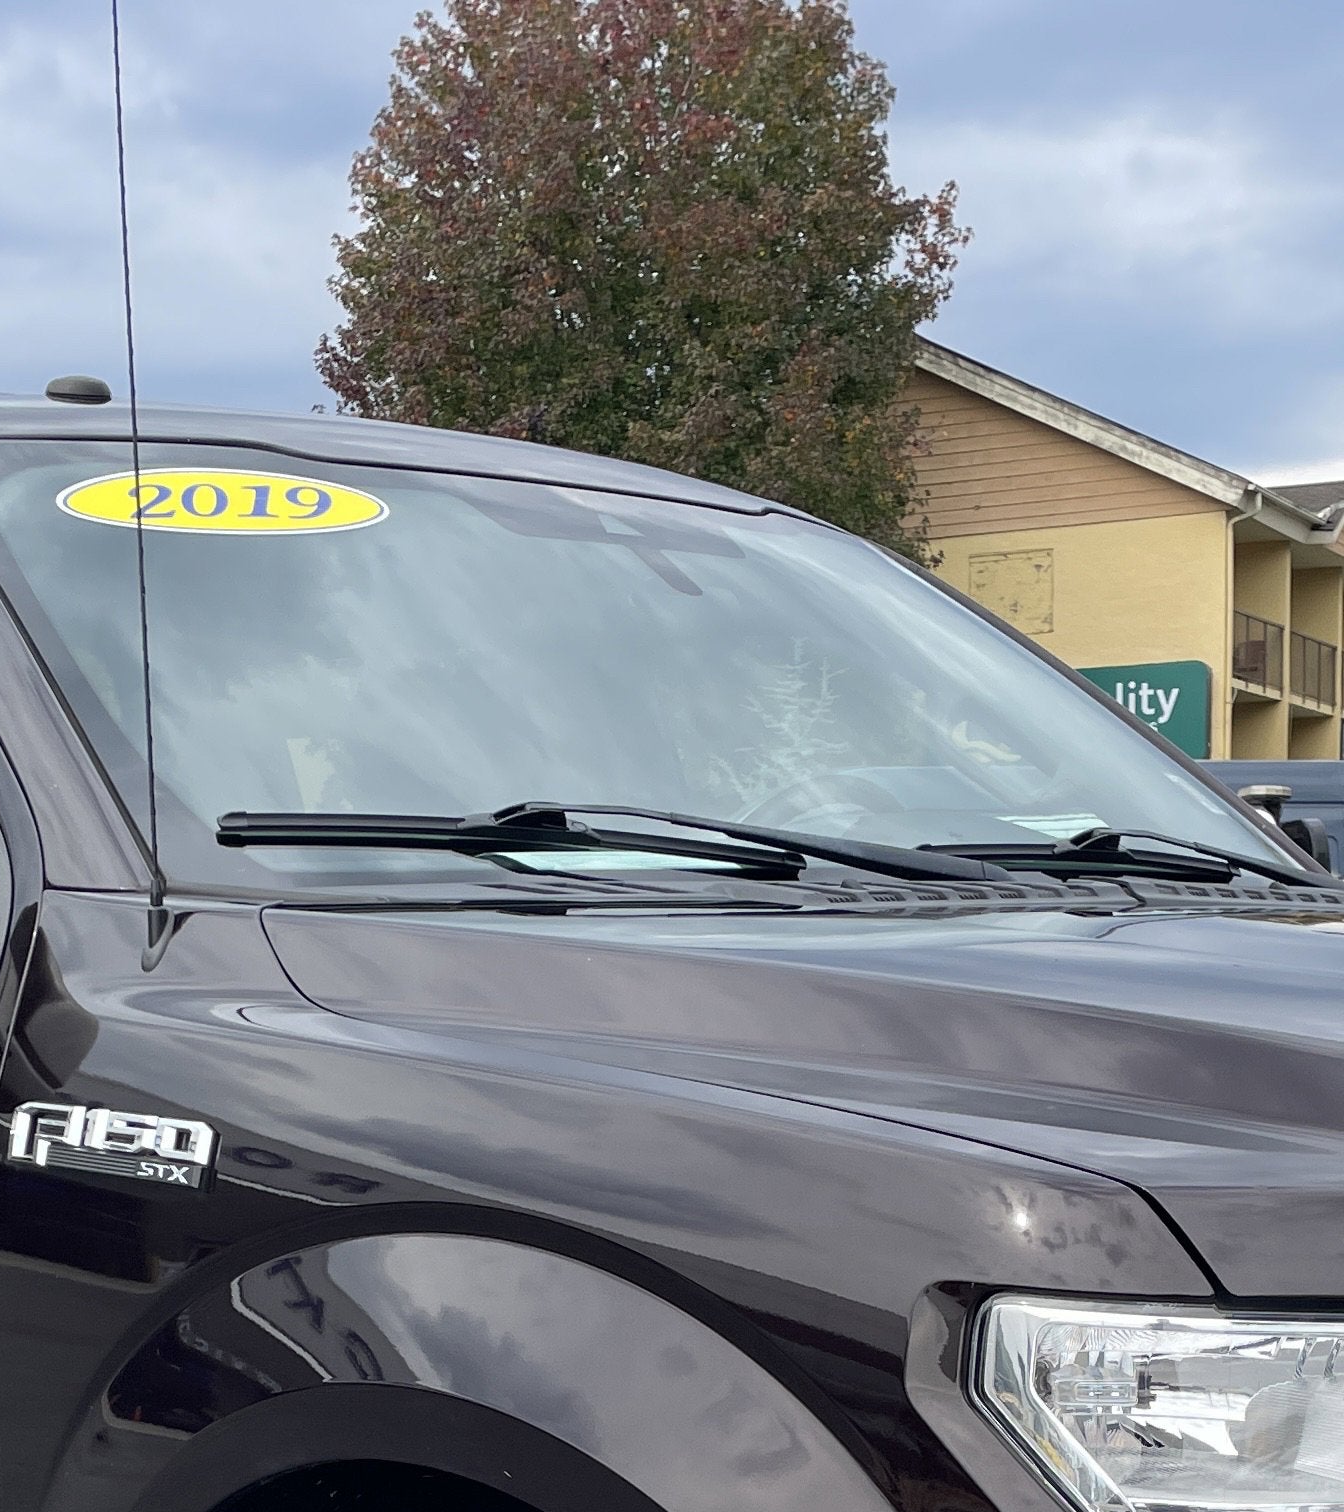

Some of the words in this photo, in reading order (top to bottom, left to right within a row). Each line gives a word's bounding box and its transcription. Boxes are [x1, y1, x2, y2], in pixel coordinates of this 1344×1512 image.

[127, 483, 333, 520] 2019
[1116, 680, 1180, 724] lity
[136, 1161, 190, 1185] STX
